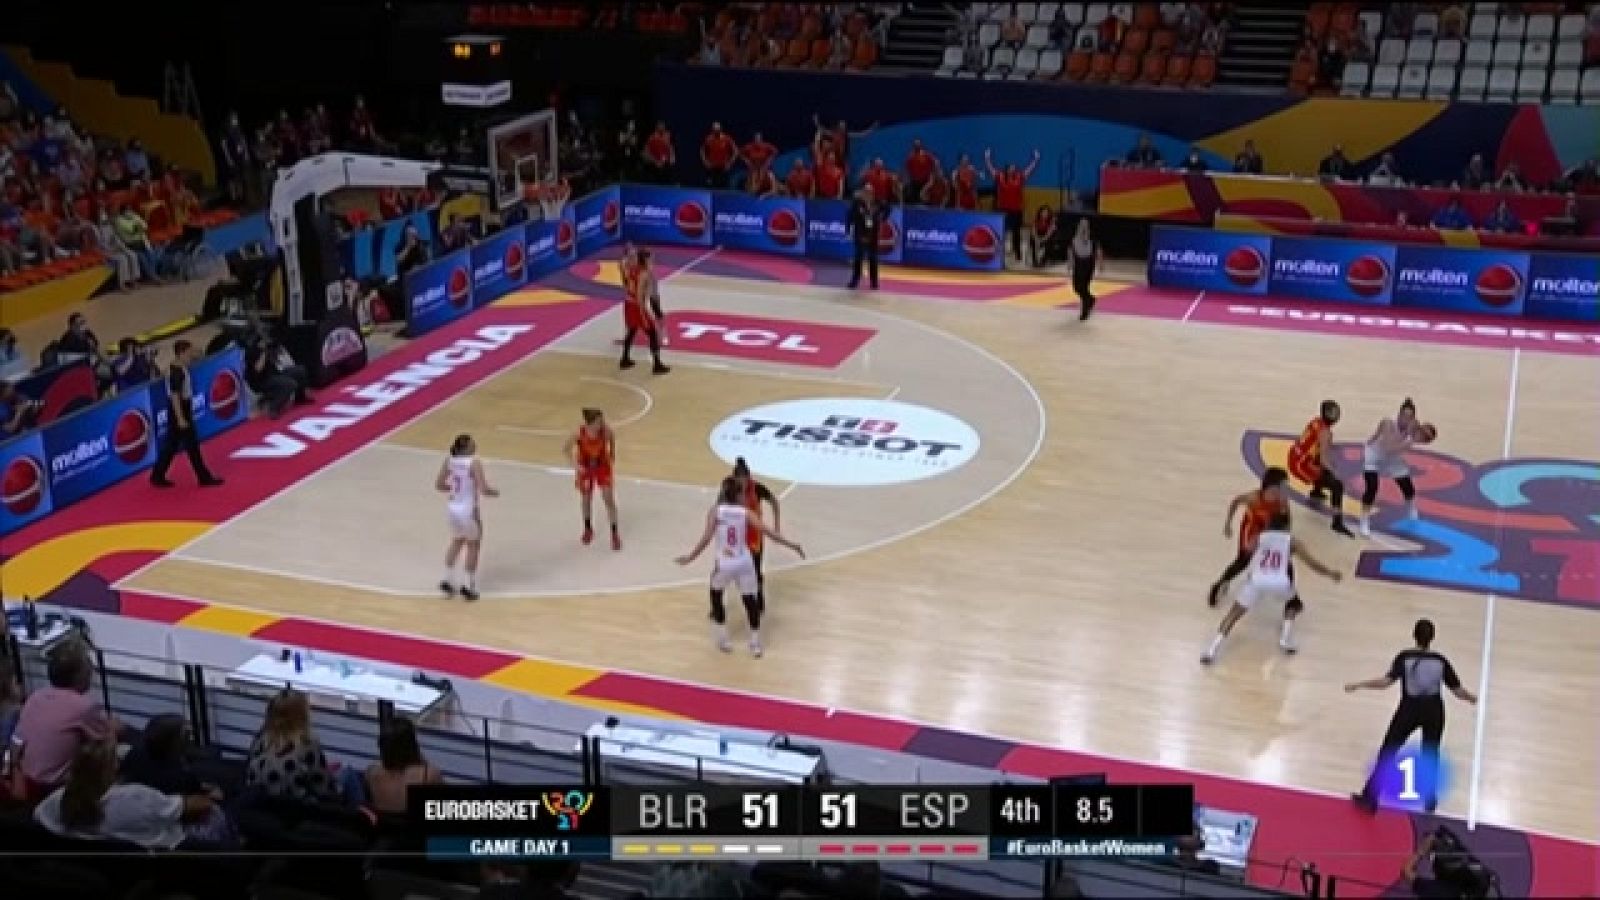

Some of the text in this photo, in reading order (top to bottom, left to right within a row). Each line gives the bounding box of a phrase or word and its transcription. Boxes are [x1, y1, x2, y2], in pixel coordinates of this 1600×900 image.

[1156, 249, 1219, 266] molten
[1274, 259, 1339, 277] molten
[1399, 268, 1469, 286] molten
[678, 322, 820, 353] TCL
[230, 323, 537, 458] VALÈNCIA
[741, 418, 963, 457] TISSOT
